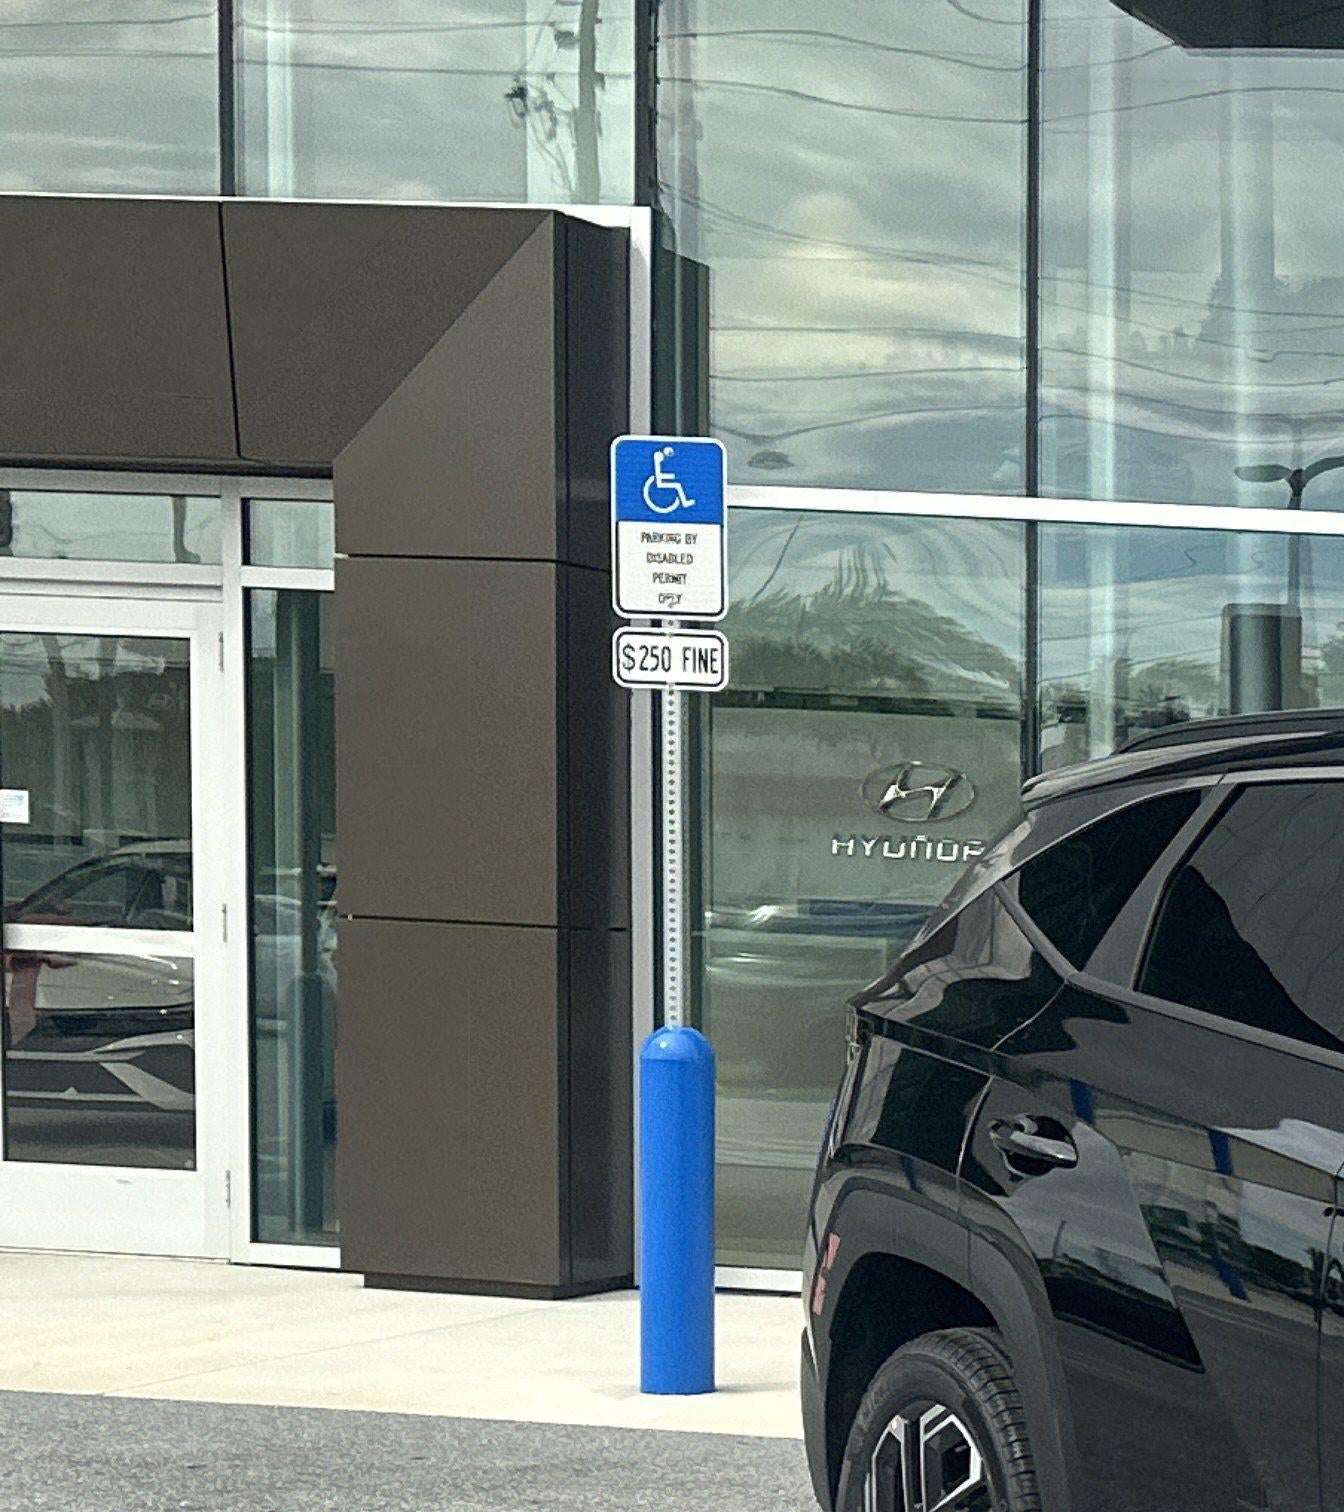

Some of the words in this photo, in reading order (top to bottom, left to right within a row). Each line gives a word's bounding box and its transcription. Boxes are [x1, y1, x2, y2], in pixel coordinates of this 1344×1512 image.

[641, 531, 681, 545] PARKING
[685, 532, 698, 545] BY
[647, 551, 693, 565] DISABLED
[653, 571, 687, 585] PERMIT
[622, 643, 672, 674] $250
[682, 646, 719, 675] FINE
